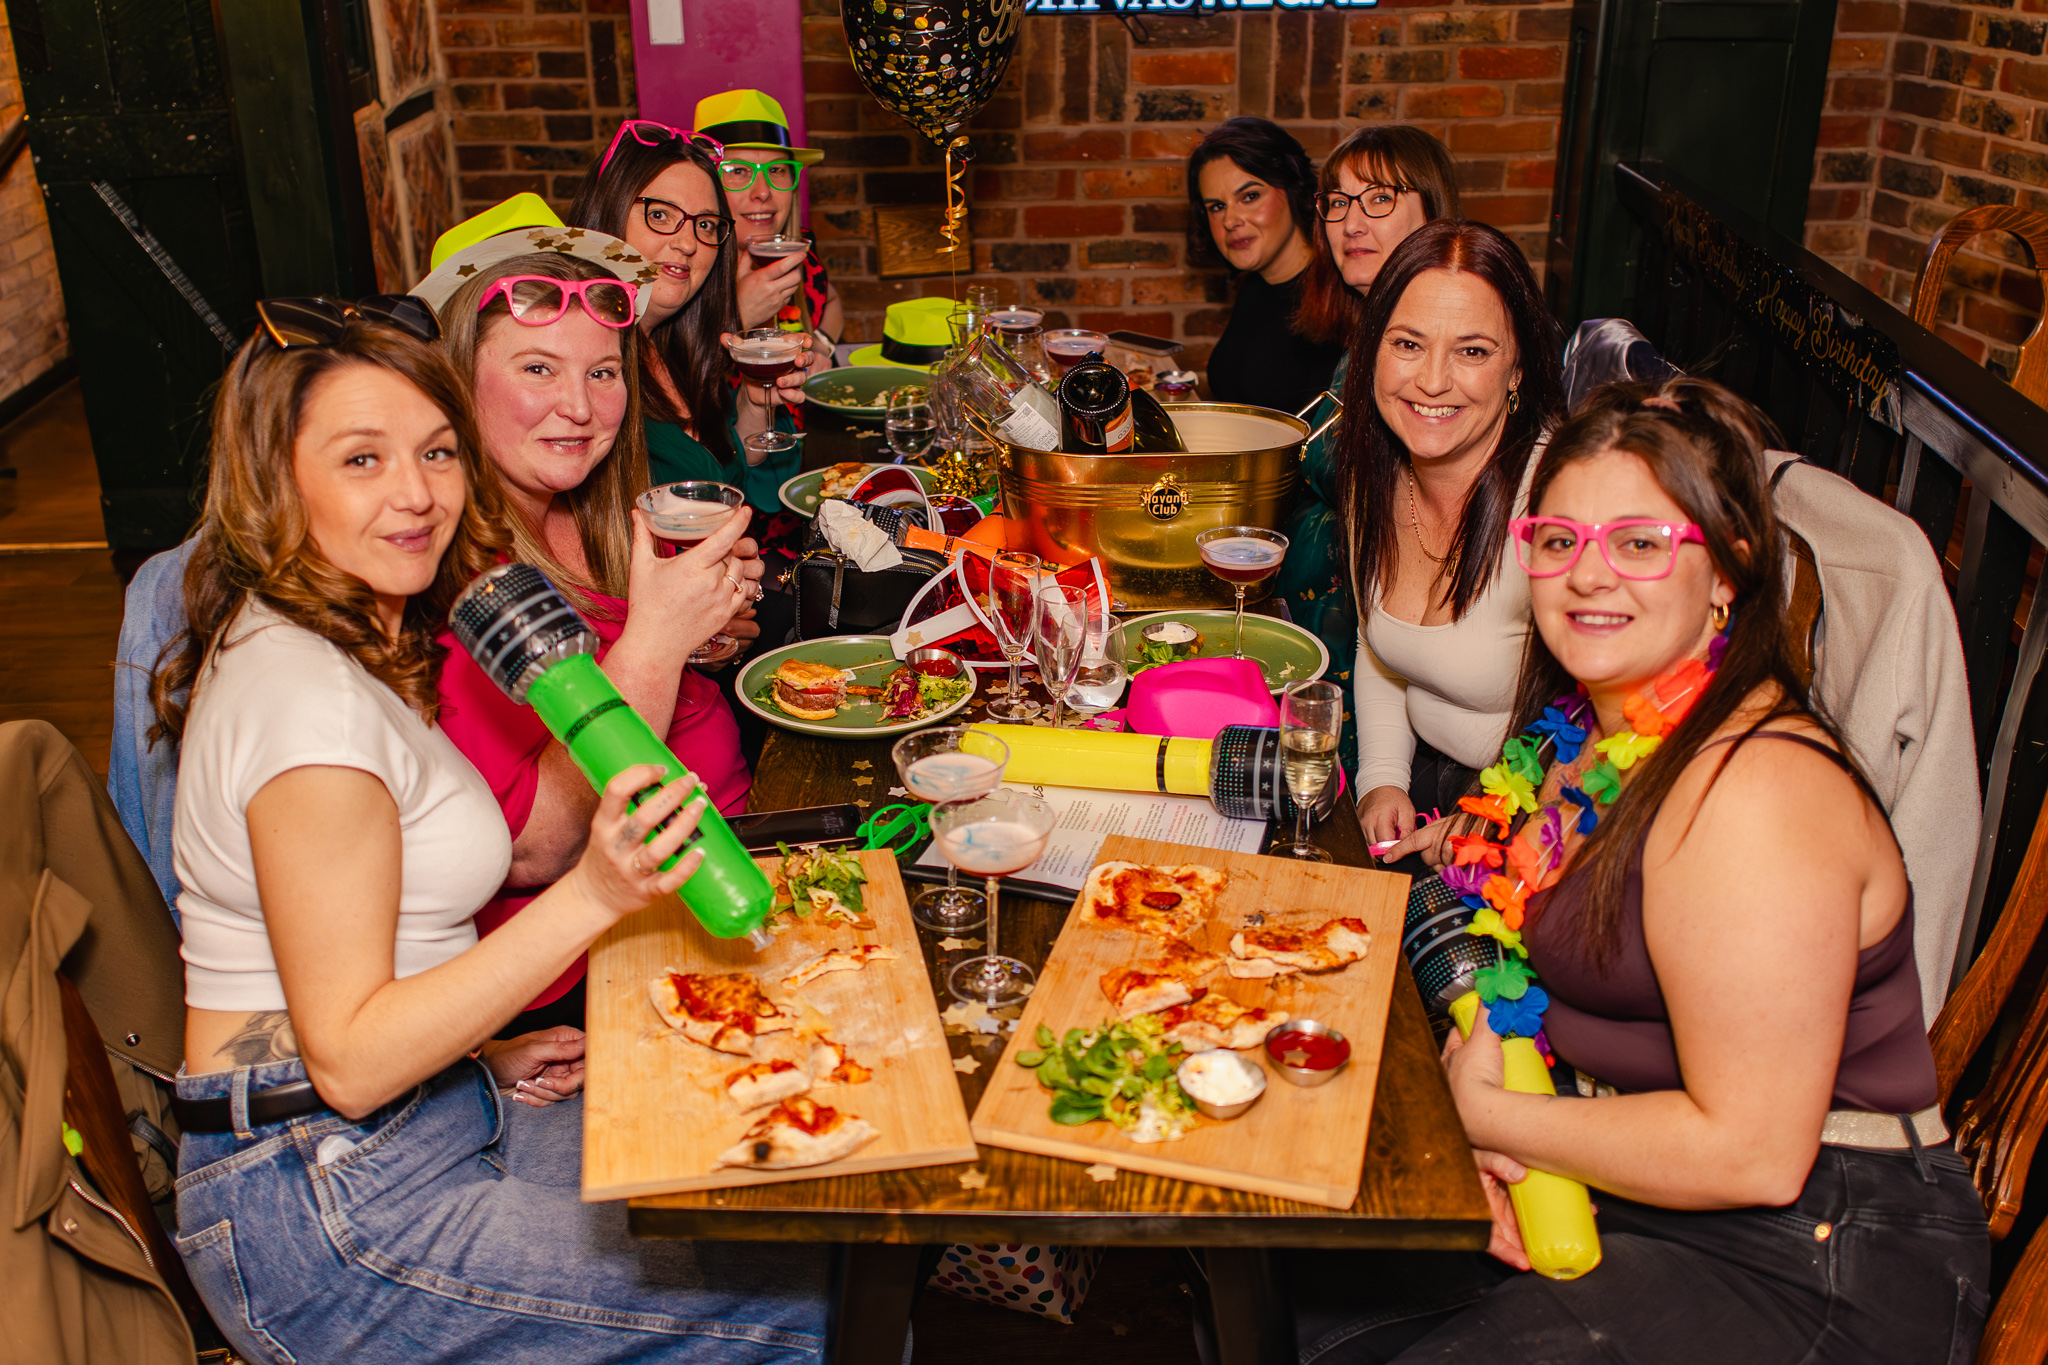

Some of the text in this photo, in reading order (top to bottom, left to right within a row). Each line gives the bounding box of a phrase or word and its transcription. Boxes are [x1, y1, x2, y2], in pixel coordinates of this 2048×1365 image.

[1758, 271, 1806, 350] Happy
[1811, 308, 1890, 411] Birthday
[1037, 430, 1051, 444] PINOT
[1144, 493, 1187, 505] Havana
[1152, 504, 1178, 515] Club
[821, 811, 840, 834] 14:45
